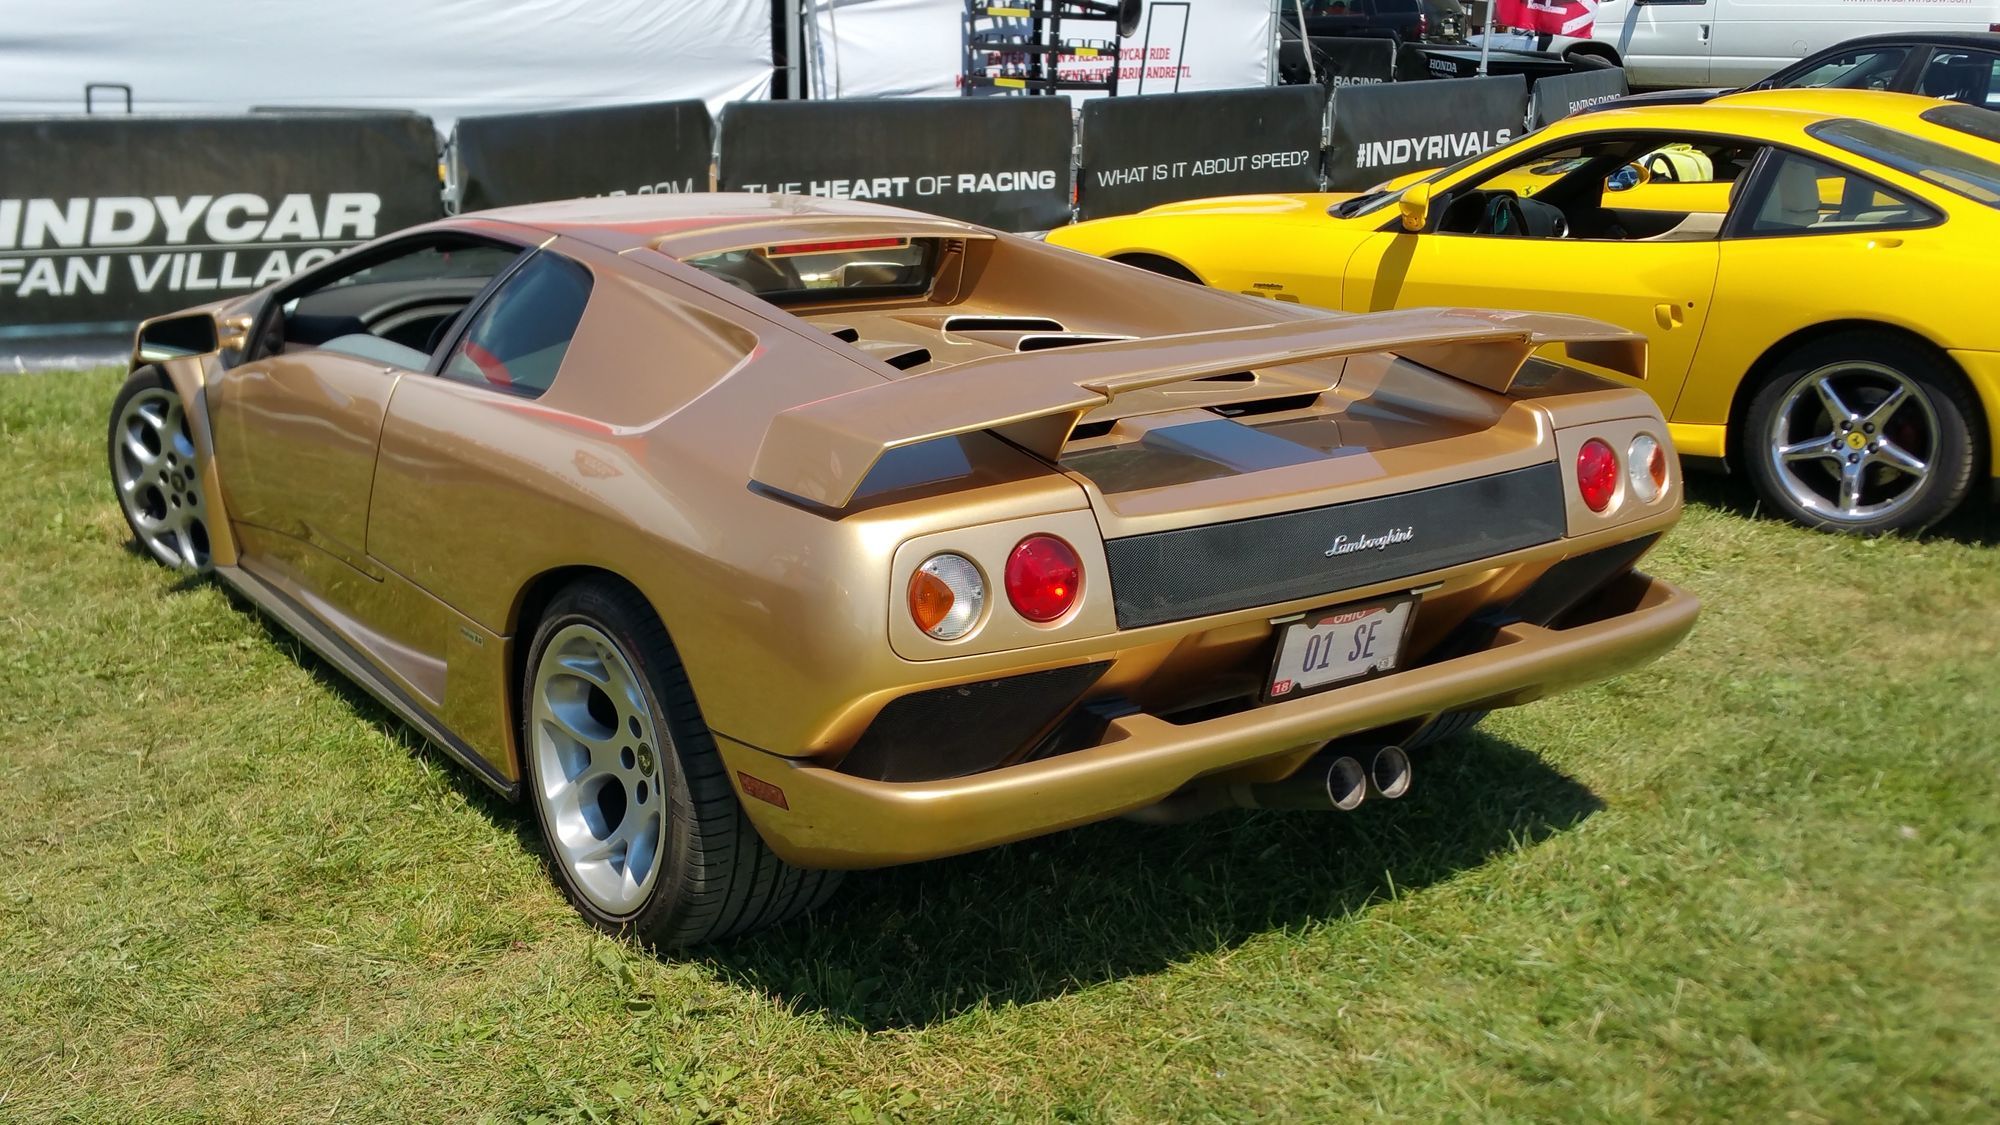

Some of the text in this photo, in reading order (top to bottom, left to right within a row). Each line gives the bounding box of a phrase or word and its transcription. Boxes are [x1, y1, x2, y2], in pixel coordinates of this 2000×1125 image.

[1150, 48, 1170, 60] RIDE
[1429, 59, 1457, 73] HONDA
[1356, 128, 1511, 168] #INDYRIVALS
[810, 177, 910, 200] HEART
[915, 175, 952, 196] OF
[957, 170, 1057, 194] RACING
[1097, 150, 1310, 187] WHAT IS IT ABOUT SPEED?
[0, 192, 381, 249] INDYCAR
[0, 248, 352, 298] FAN VILLAG
[1324, 526, 1414, 557] Lamborghini
[1348, 619, 1383, 662] SE
[1274, 681, 1291, 694] 18
